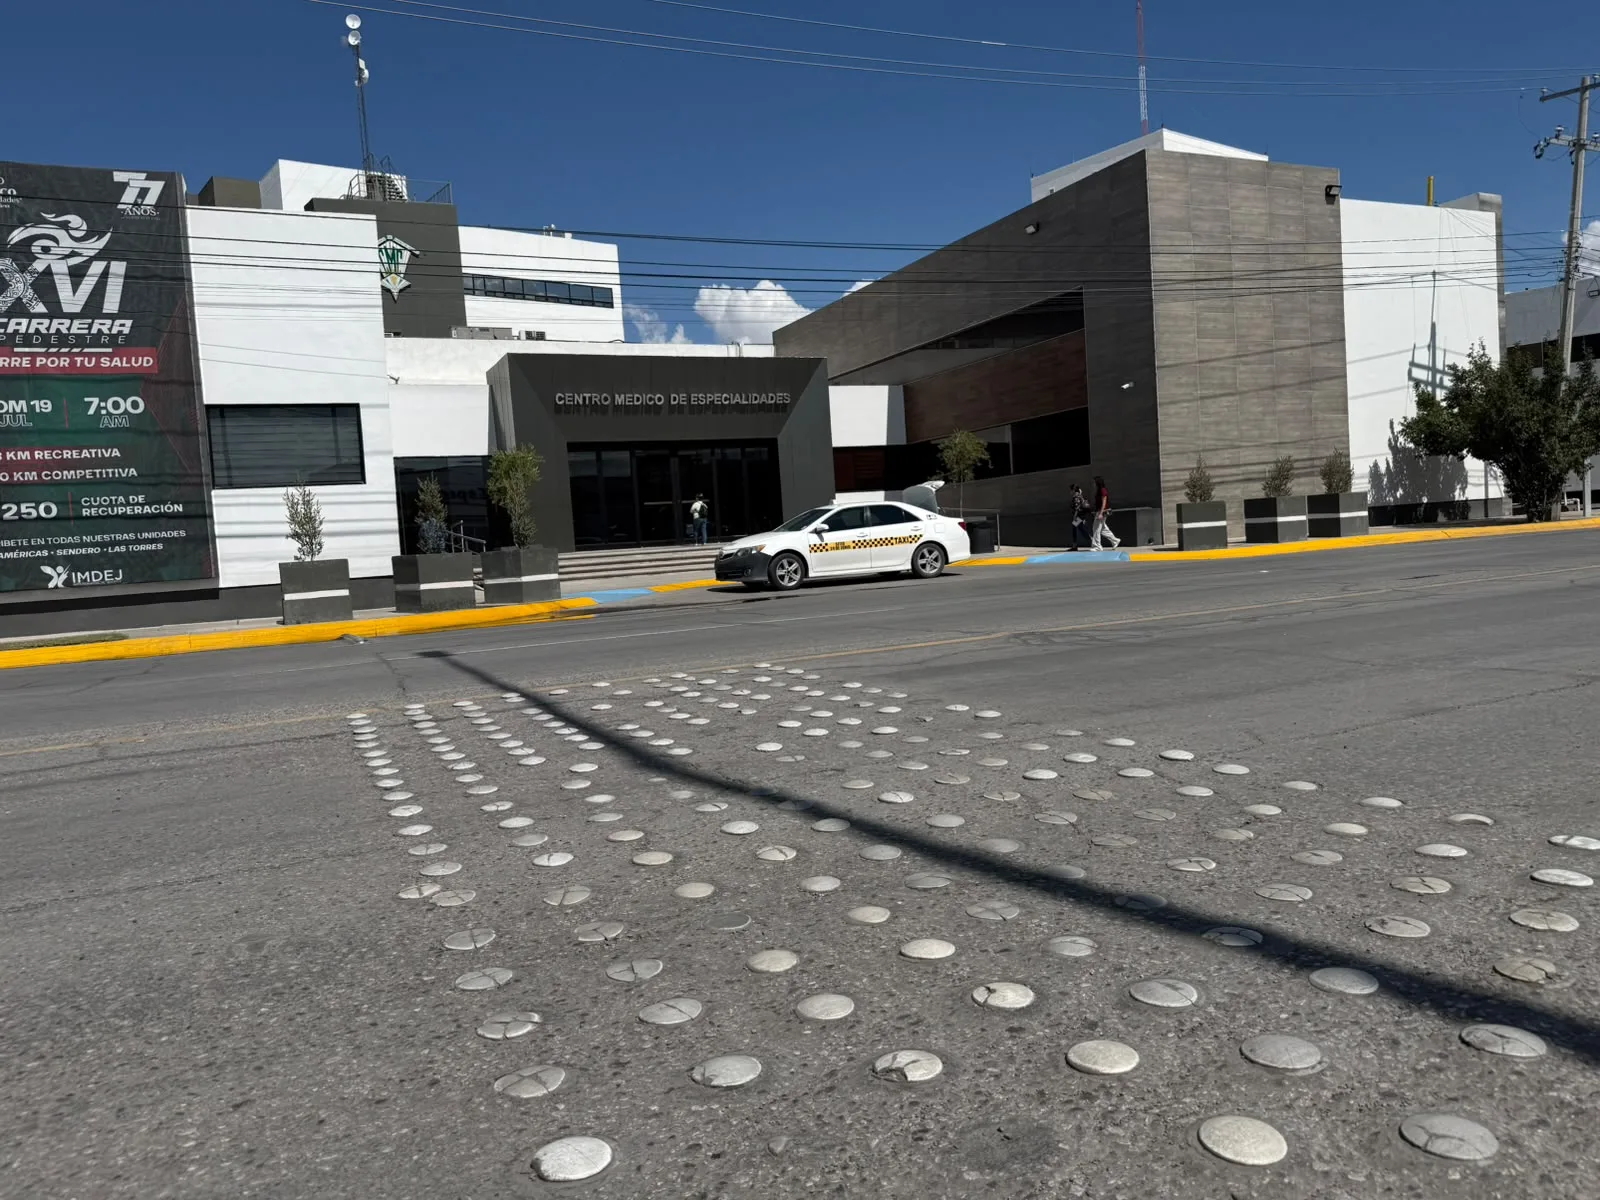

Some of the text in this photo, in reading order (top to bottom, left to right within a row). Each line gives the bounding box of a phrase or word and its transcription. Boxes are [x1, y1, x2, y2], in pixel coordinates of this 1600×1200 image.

[113, 171, 166, 209] 77
[36, 357, 70, 368] POR
[74, 357, 96, 367] TU
[100, 356, 154, 367] SALUD
[555, 392, 791, 405] CENTRO MEDICO DE ESPECIALIDADES
[30, 400, 53, 413] 19
[84, 396, 145, 415] 7:00
[100, 415, 130, 428] AM
[6, 450, 31, 461] KM
[34, 448, 121, 460] RECREATIVA
[13, 471, 38, 481] KM
[41, 468, 138, 480] COMPETITIVA
[81, 494, 146, 506] CUOTA DE
[2, 502, 58, 520] 250
[82, 501, 183, 517] RECUPERACIÓN
[31, 538, 46, 546] EN
[46, 535, 81, 545] TODAS
[82, 532, 136, 543] NUESTRAS
[137, 530, 187, 539] UNIDADES
[894, 536, 910, 545] TAXI
[56, 547, 101, 556] SENDERO
[108, 545, 127, 553] LAS
[128, 543, 164, 552] TORRES
[72, 569, 123, 583] IMDEJ
